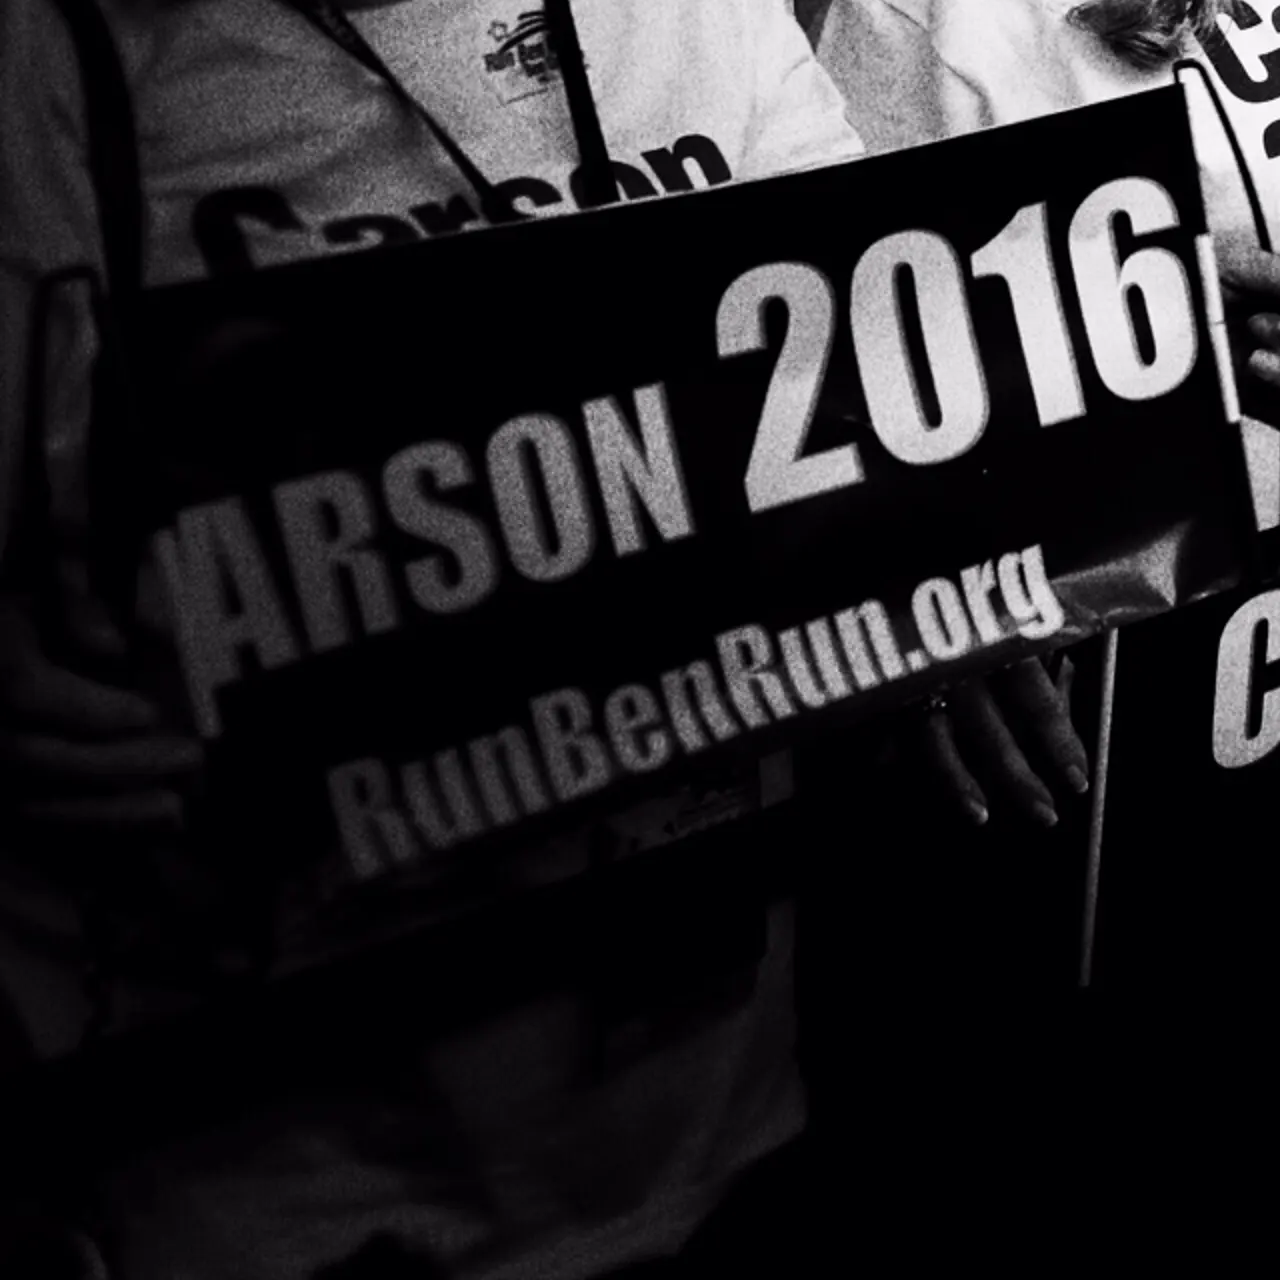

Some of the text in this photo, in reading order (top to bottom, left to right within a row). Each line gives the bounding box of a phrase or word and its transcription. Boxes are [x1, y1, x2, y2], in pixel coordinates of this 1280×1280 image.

[138, 174, 1200, 732] ARSON 2016
[325, 542, 1066, 882] RunBenRun.org
